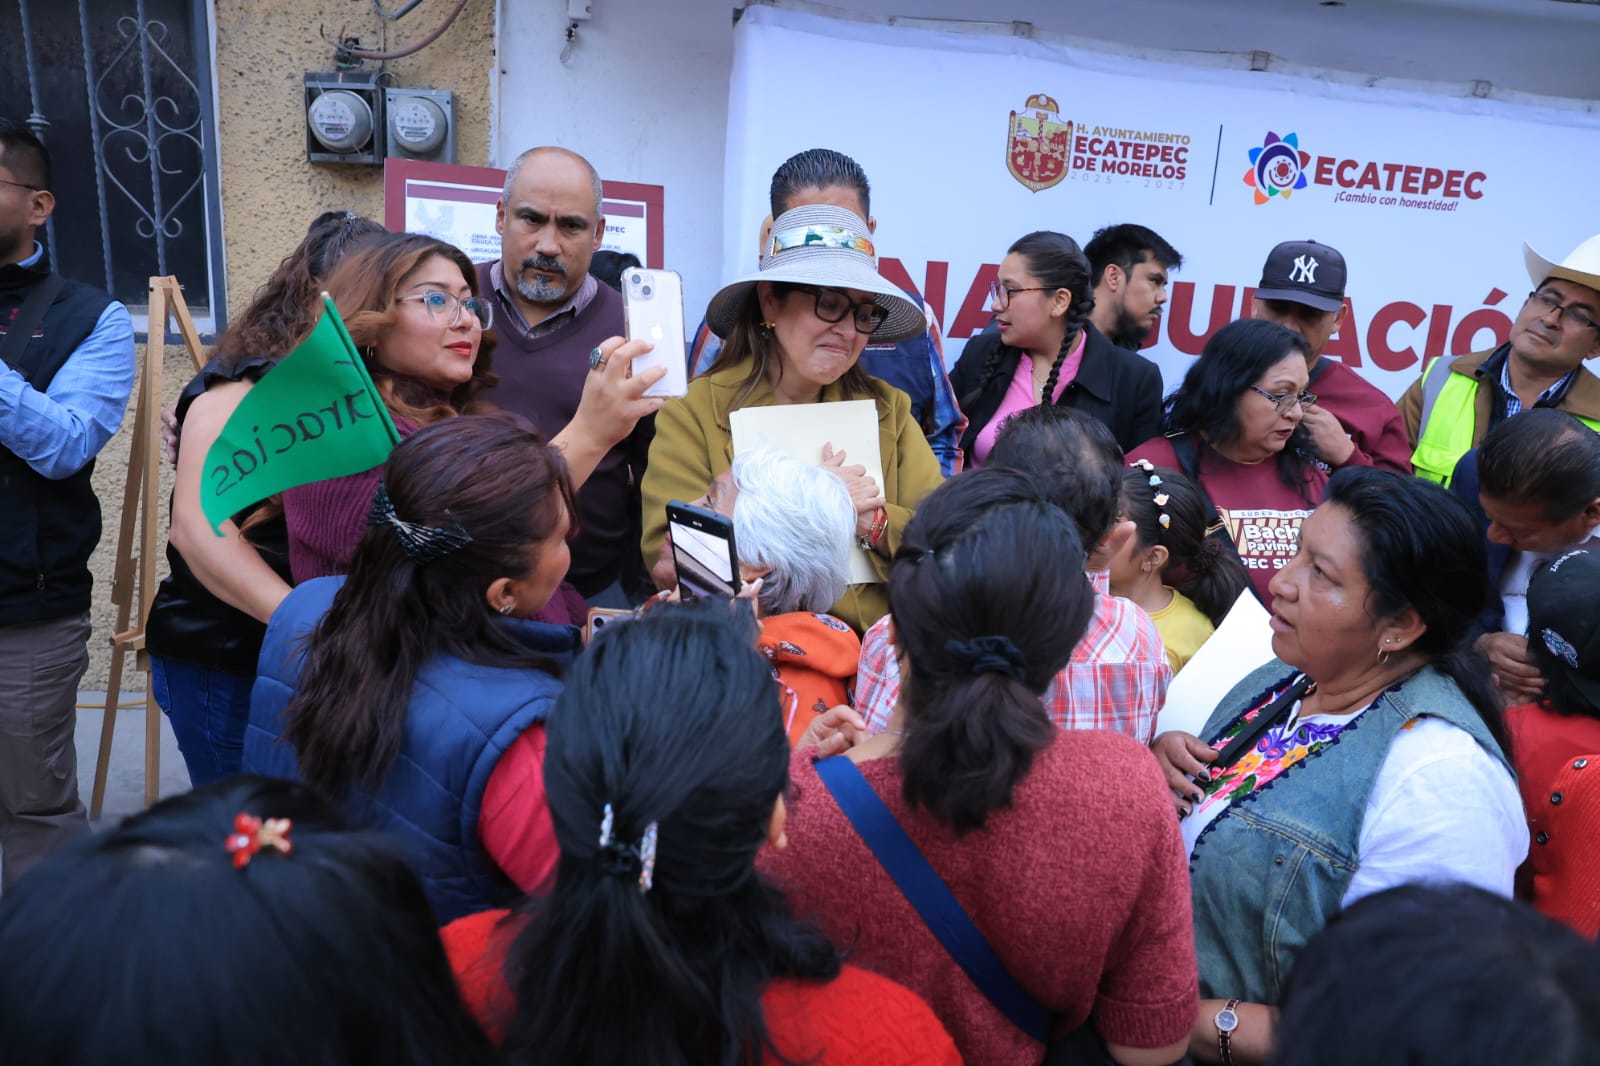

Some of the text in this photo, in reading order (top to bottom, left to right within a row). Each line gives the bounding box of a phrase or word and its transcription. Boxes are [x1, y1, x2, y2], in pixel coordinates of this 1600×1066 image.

[1077, 123, 1191, 146] H. AYUNTAMIENTO
[1074, 135, 1189, 165] ECATEPEC
[1071, 171, 1112, 184] 2025
[1072, 155, 1186, 180] DE MORELOS
[1314, 155, 1487, 200] ECATEPEC
[1334, 191, 1459, 212] ¡Cambio con honestidad!
[1288, 254, 1319, 284] NY
[1244, 524, 1300, 540] Bach
